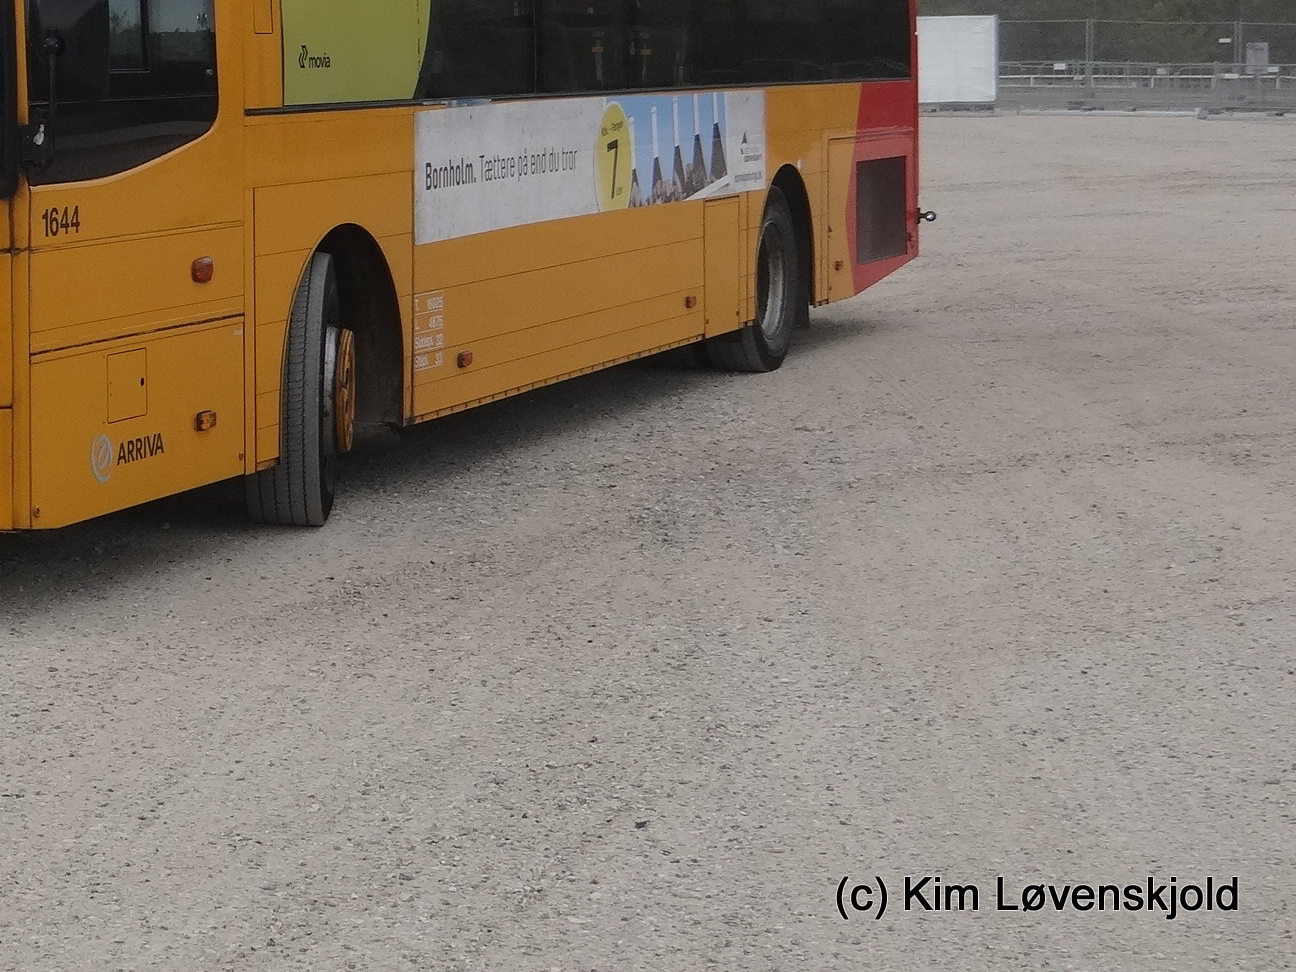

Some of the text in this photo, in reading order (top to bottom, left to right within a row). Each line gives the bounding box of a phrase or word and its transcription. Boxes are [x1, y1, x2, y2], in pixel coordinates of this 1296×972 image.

[308, 52, 331, 69] movia
[425, 146, 578, 191] Bornholm. Tættere på end du tror
[606, 138, 619, 200] 7
[41, 205, 81, 237] 1644
[117, 433, 165, 466] ARRIVA
